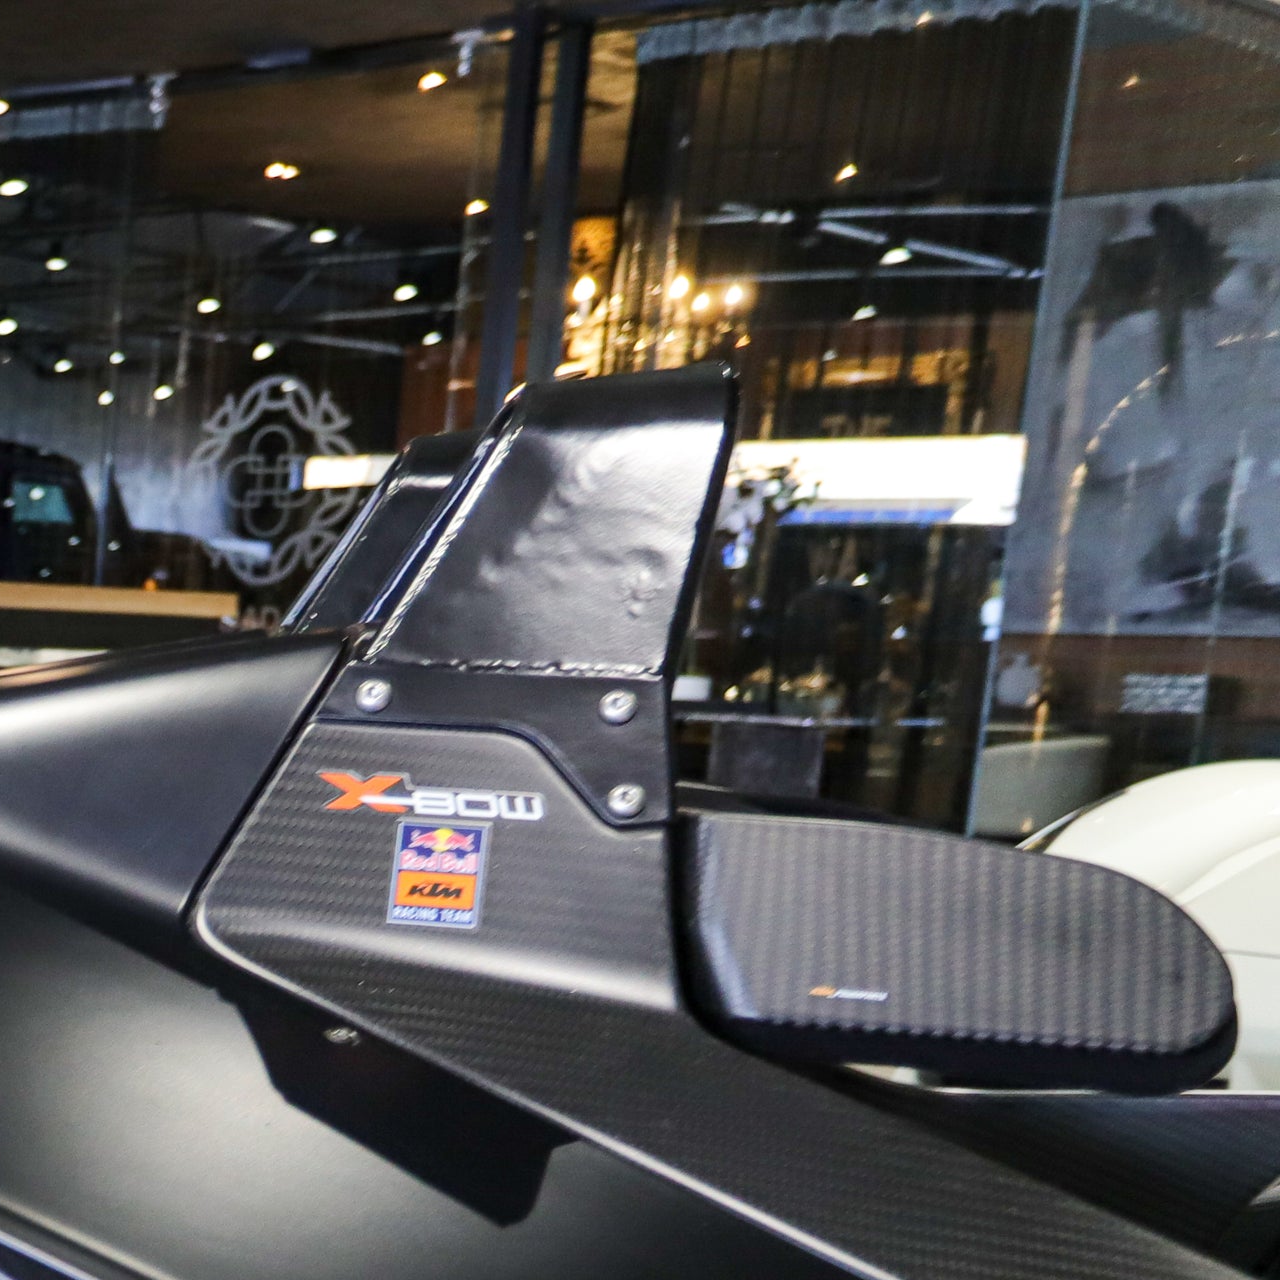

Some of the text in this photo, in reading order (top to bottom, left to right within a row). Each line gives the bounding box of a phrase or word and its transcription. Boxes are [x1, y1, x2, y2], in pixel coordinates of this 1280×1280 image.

[399, 848, 478, 874] Red Bull
[407, 883, 464, 899] KTM
[392, 905, 438, 921] RACING
